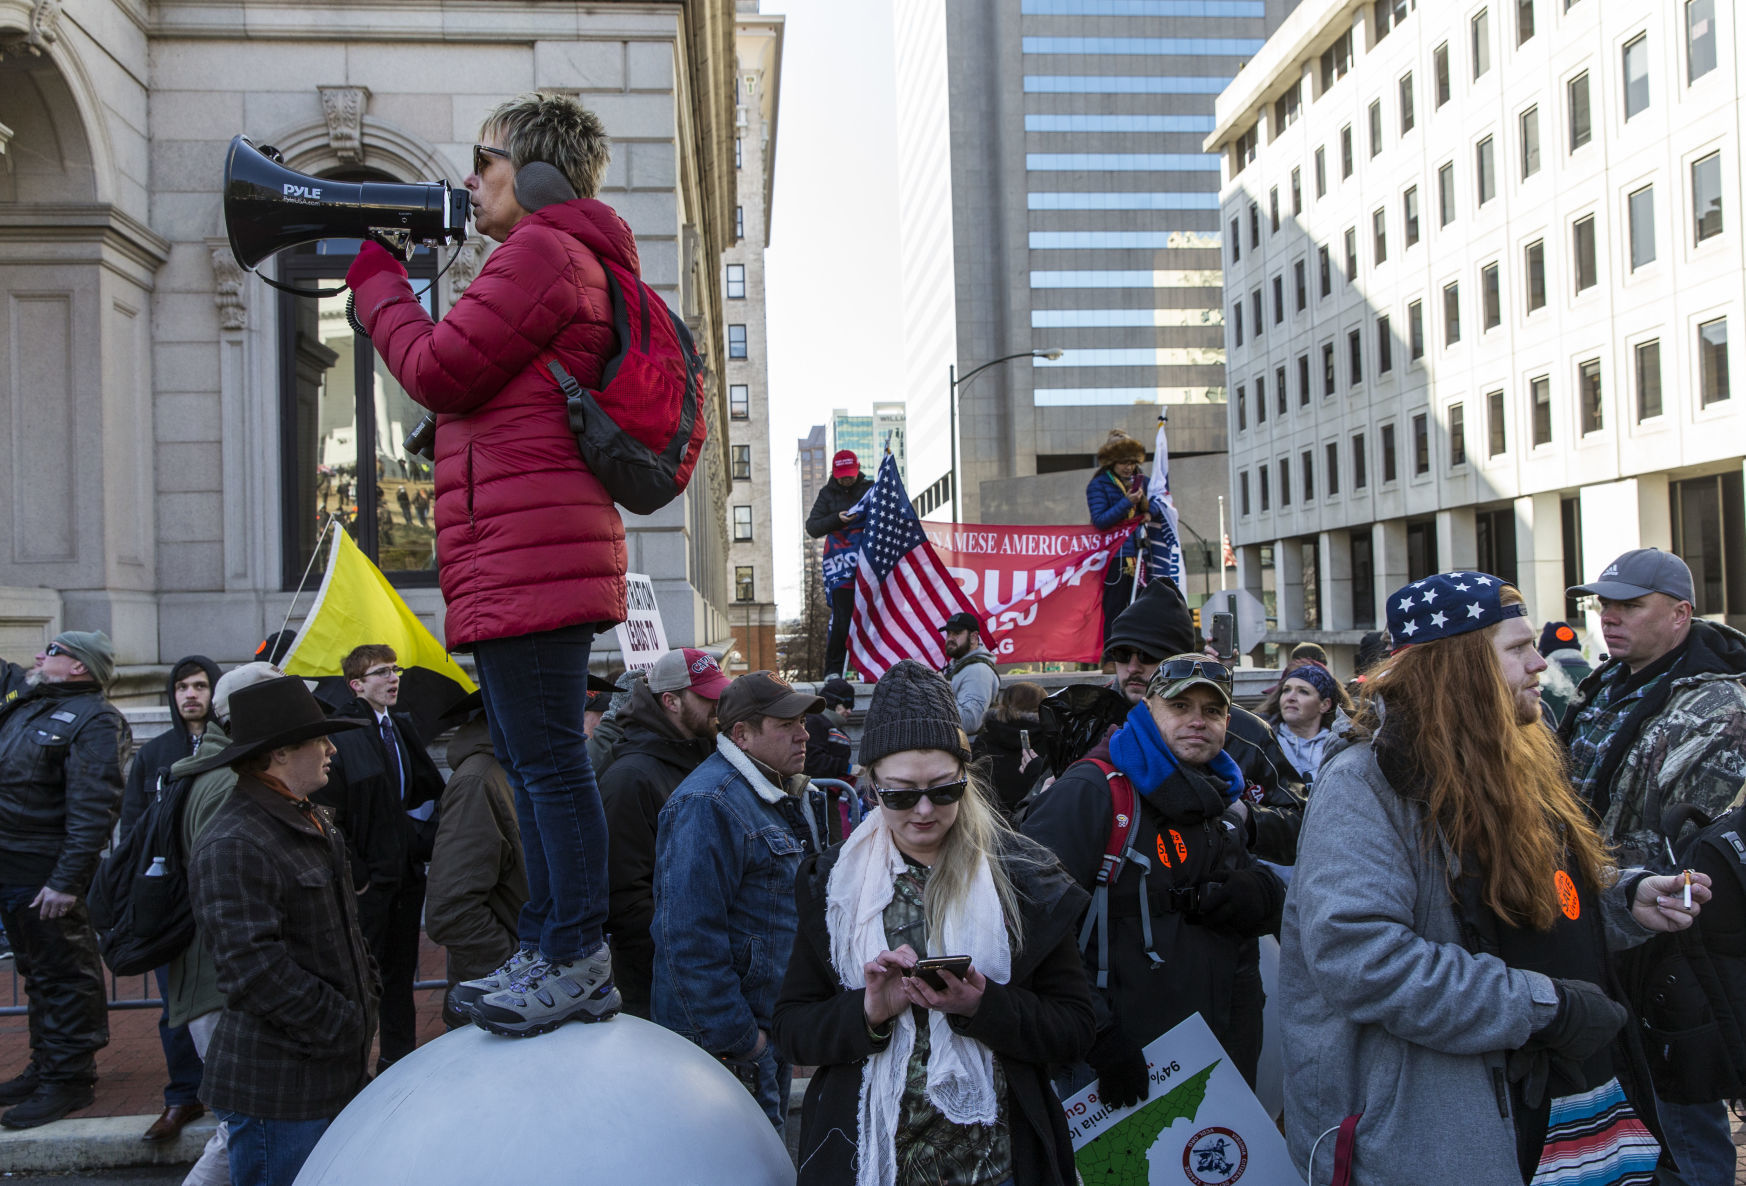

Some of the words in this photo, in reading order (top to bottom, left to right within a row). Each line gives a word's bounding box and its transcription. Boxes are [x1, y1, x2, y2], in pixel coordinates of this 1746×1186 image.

[283, 183, 321, 199] PYLE
[925, 531, 992, 553] NAMESE
[999, 533, 1100, 555] AMERICANS
[947, 550, 1110, 616] RUMP
[625, 620, 650, 652] LEADS
[645, 620, 659, 651] TO
[1250, 784, 1265, 804] 2A
[1150, 1060, 1180, 1085] 94%
[1080, 1103, 1114, 1128] ginia
